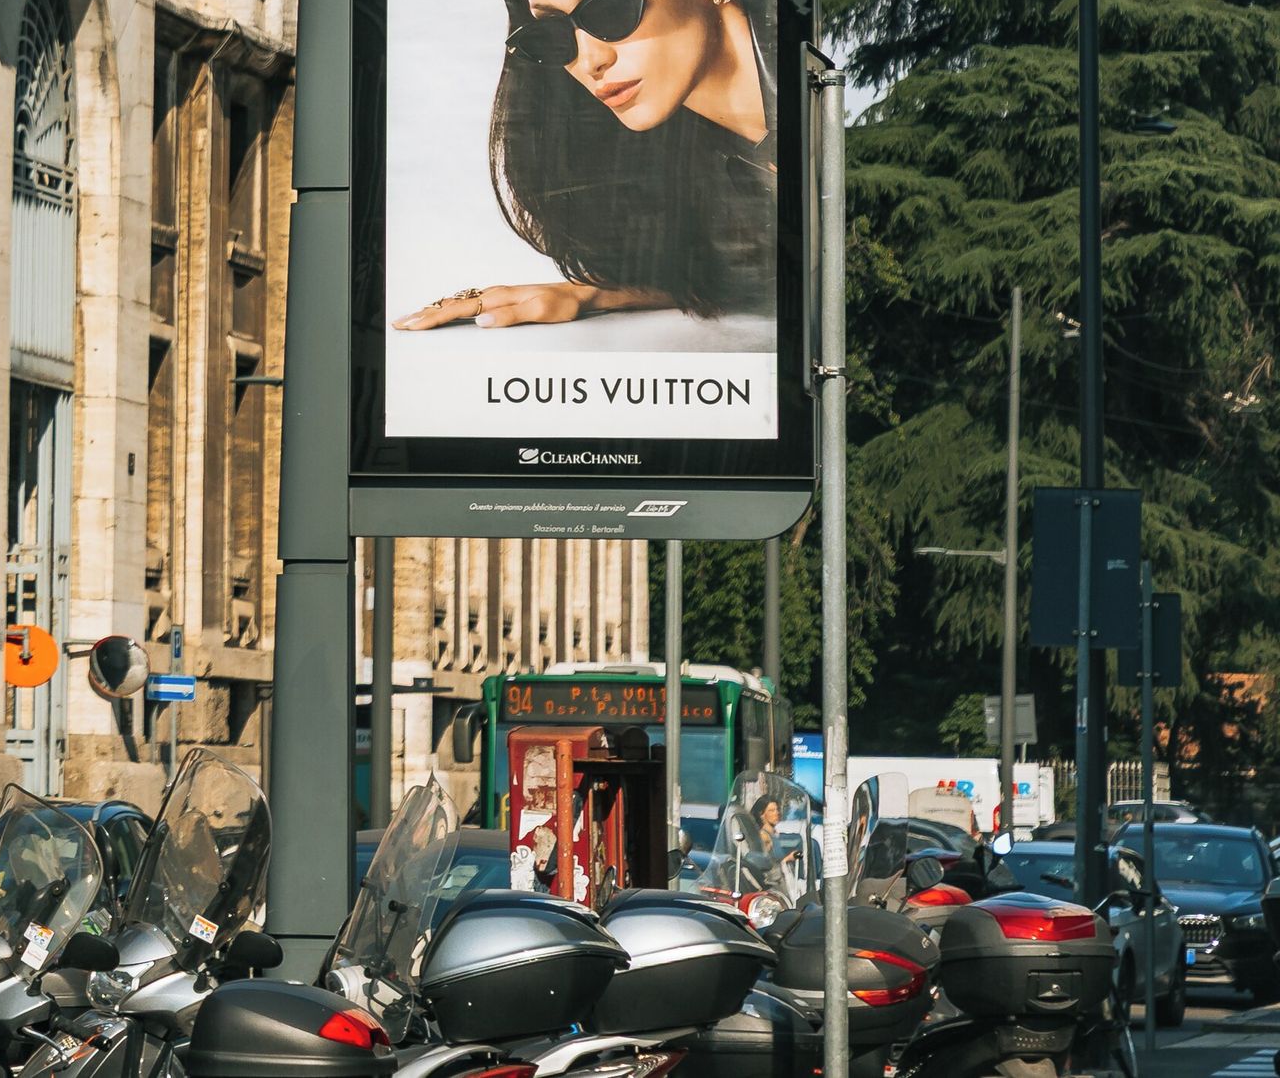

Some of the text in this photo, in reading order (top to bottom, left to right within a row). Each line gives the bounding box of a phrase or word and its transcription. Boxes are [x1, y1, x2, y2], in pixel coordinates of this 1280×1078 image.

[487, 377, 751, 405] LOUIS VUITTON
[469, 503, 493, 511] Questo
[494, 503, 523, 512] impianto
[523, 503, 565, 512] pubblicitario
[566, 503, 593, 511] finanzia
[600, 504, 626, 512] servizio
[533, 524, 565, 532] Stazione
[567, 524, 585, 533] n.65
[591, 524, 625, 533] Bertarelli
[508, 686, 533, 715] 94
[571, 686, 667, 702] P.ta VOLT
[597, 701, 714, 717] Policliico
